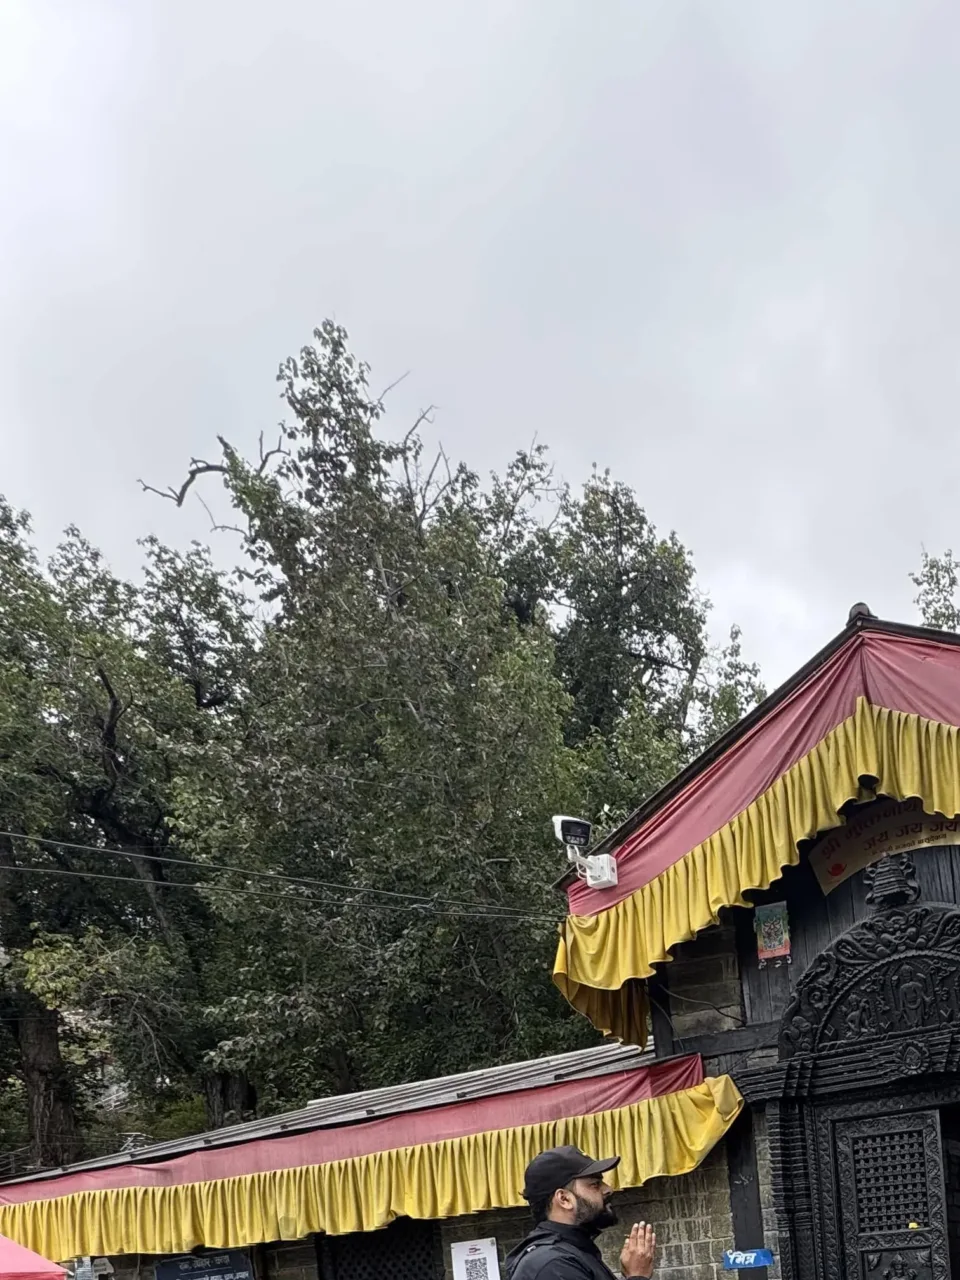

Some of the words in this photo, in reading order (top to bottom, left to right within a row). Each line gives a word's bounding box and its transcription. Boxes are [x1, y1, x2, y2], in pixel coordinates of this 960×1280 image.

[863, 832, 889, 850] जय
[895, 821, 924, 837] जय
[929, 818, 960, 833] जय
